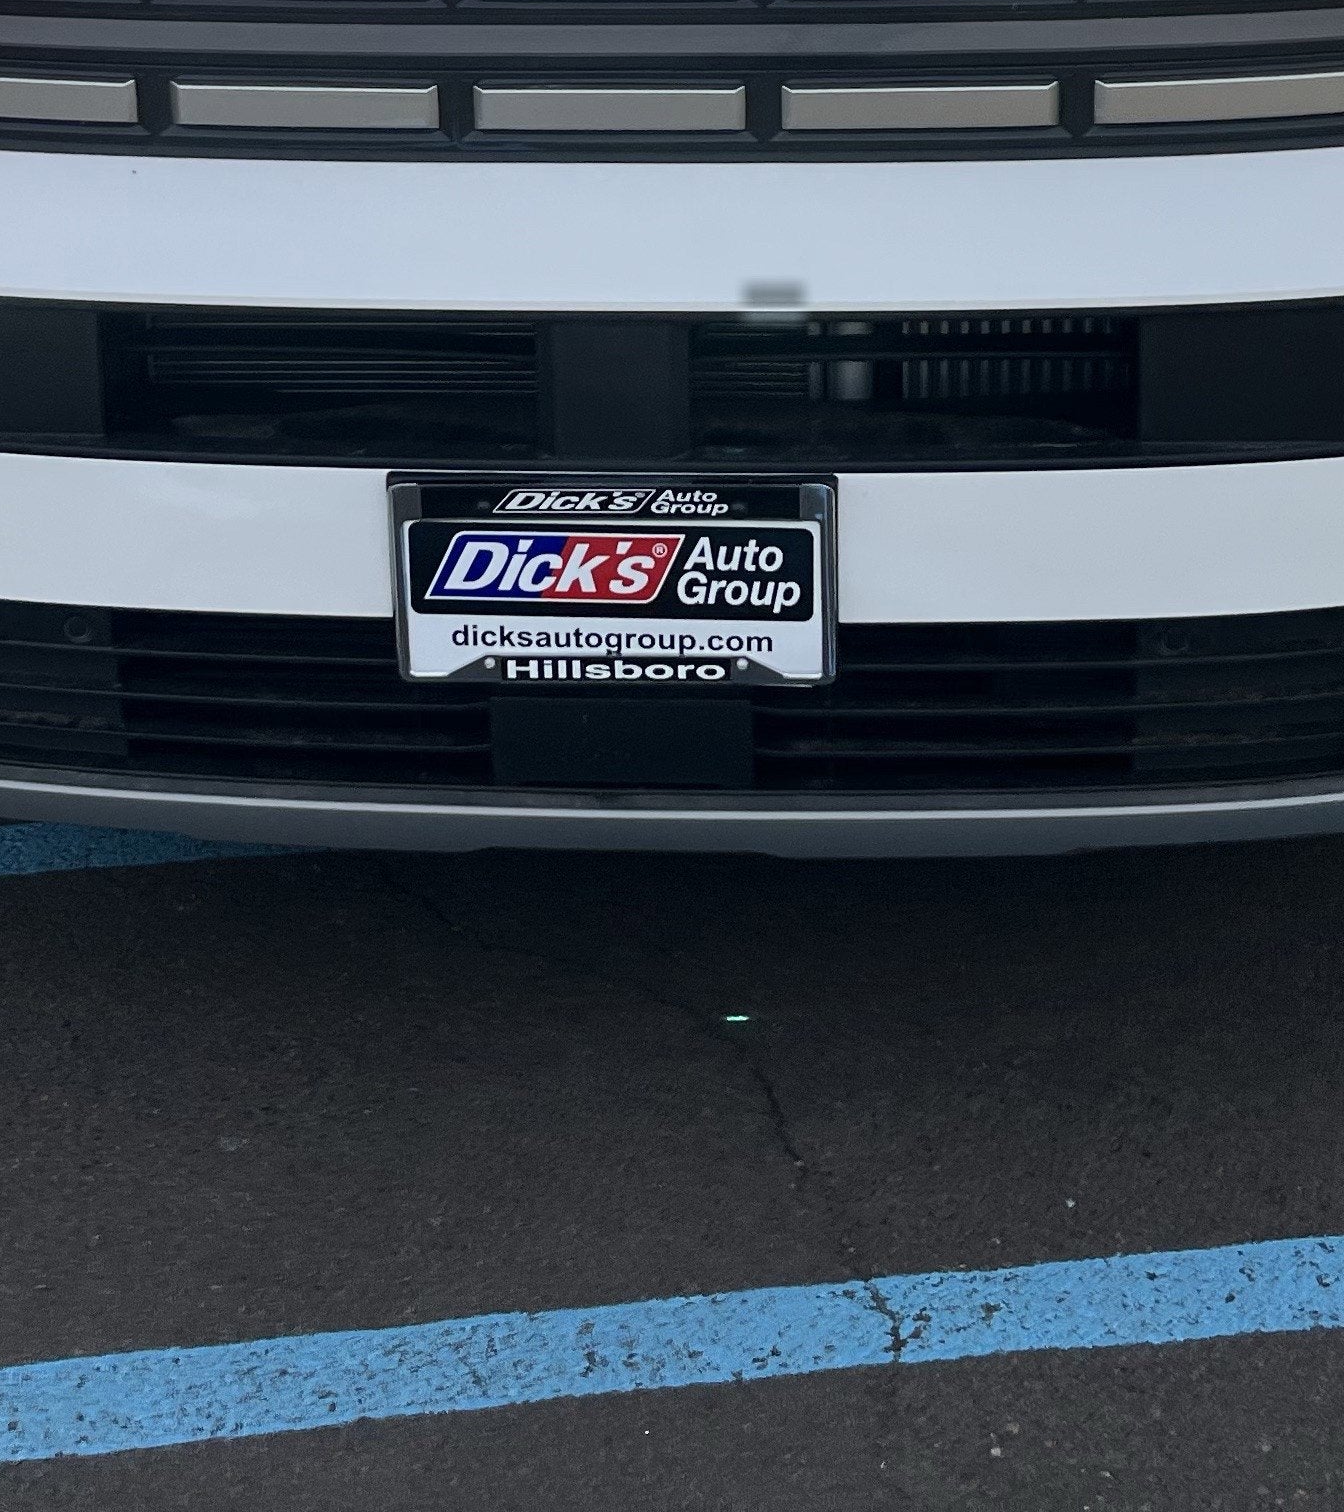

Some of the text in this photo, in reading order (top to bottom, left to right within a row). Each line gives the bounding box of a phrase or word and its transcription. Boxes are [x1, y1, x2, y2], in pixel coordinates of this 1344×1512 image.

[650, 500, 729, 516] Group
[656, 489, 717, 502] Auto
[683, 536, 783, 572] Auto
[677, 571, 801, 613] Group
[451, 624, 773, 654] dicksautogroup.com
[506, 659, 726, 681] Hillsboro
